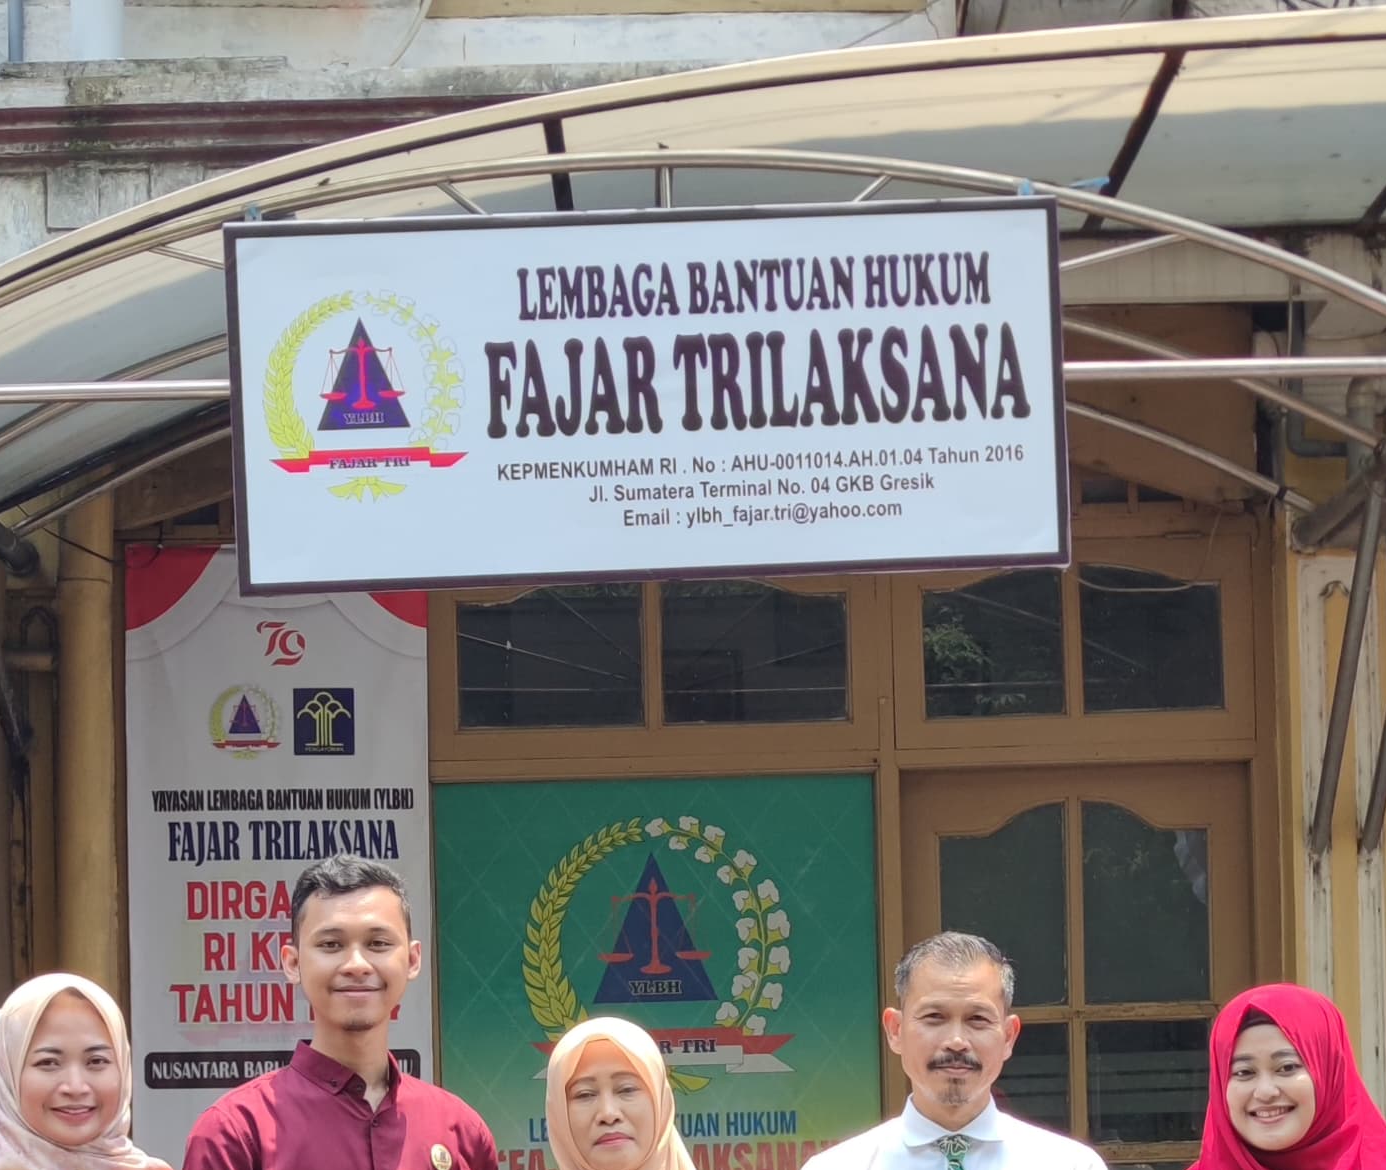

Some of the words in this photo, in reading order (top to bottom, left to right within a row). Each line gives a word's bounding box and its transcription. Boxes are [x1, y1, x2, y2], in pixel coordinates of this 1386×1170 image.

[517, 264, 680, 320] LEMBAGA
[687, 256, 855, 314] BANTUAN
[863, 251, 991, 308] HUKUM
[484, 336, 663, 439] FAJAR
[673, 321, 1031, 431] TRILAKSANA
[329, 457, 377, 469] FAJAR
[383, 456, 411, 467] TRI
[497, 458, 654, 481] KEPMENKUMHAM
[660, 457, 677, 475] RI
[692, 456, 715, 474] No
[731, 449, 923, 472] AHU-0011014.AH.01.04
[928, 446, 979, 465] Tahun
[985, 444, 1024, 462] 2016
[589, 485, 608, 502] Jl.
[614, 483, 694, 501] Sumatera
[699, 479, 771, 498] Terminal
[777, 478, 805, 495] No.
[812, 476, 830, 493] 04
[836, 475, 874, 492] GKB
[880, 472, 935, 491] Gresik
[623, 508, 670, 527] Email
[686, 502, 902, 528] ylbh_fajar.tri@yahoo.com
[256, 621, 305, 666] 79
[152, 790, 204, 812] YAYASAN
[207, 789, 263, 811] LEMBAGA
[266, 789, 323, 810] BANTUAN
[326, 788, 370, 810] HUKUM
[168, 821, 240, 867] FAJAR
[248, 820, 399, 860] TRILAKSANA
[203, 932, 236, 972] RI
[170, 983, 294, 1023] TAHUN
[630, 981, 681, 995] YLBH
[679, 1039, 717, 1054] TRI
[152, 1061, 239, 1079] NUSANTARA
[726, 1110, 797, 1137] HUKUM
